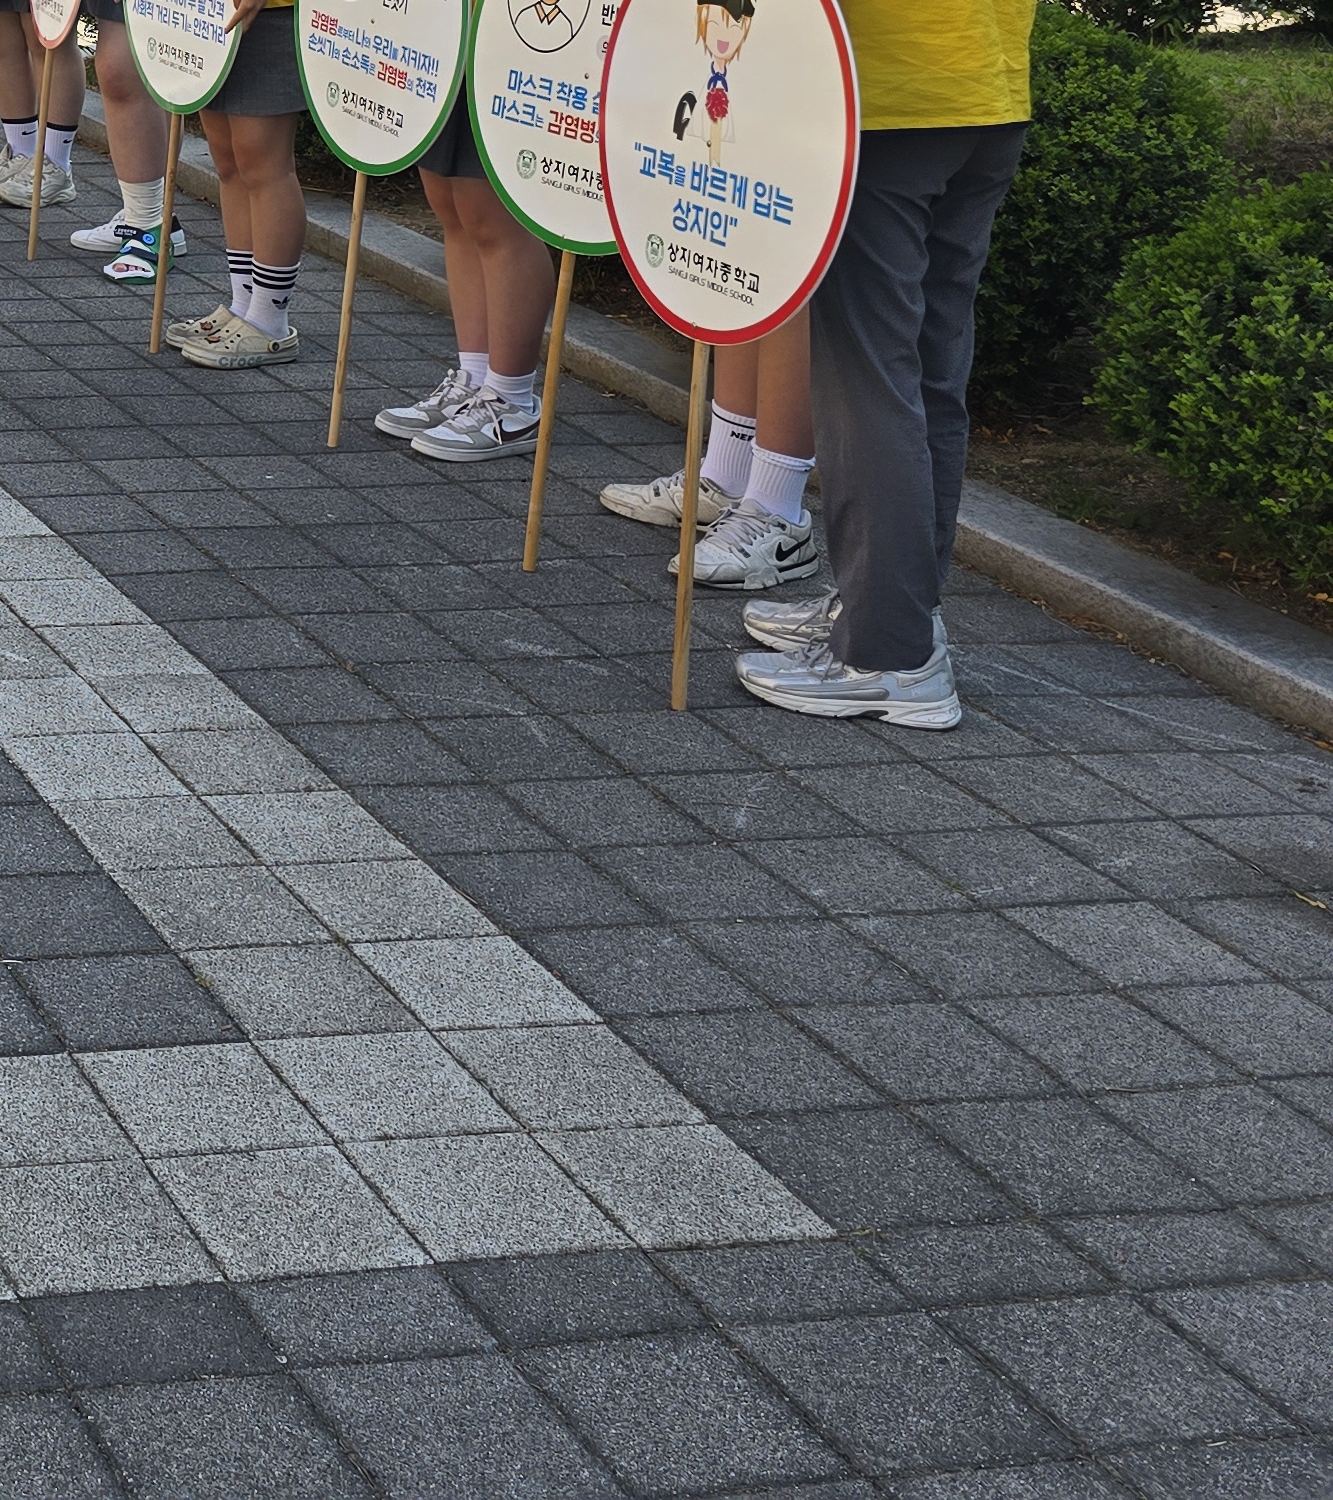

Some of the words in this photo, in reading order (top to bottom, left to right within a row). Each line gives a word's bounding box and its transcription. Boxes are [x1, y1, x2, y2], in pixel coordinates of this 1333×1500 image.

[155, 4, 171, 27] 거리
[193, 17, 226, 46] 안전거리
[310, 9, 355, 41] 감염병로부터
[372, 35, 399, 61] 우리를
[400, 45, 440, 78] 지키자!!
[157, 41, 204, 71] 상지여자중학교
[341, 46, 376, 77] 손소독은
[376, 61, 415, 93] 감염병의
[415, 76, 439, 104] 천적
[341, 88, 404, 129] 상지여자중학교
[507, 69, 554, 102] 마스크
[556, 81, 589, 111] 착용
[491, 94, 545, 129] 마스크는
[541, 176, 563, 189] SANGJI
[581, 188, 604, 203] MIDDLE
[690, 161, 749, 210] 바르게
[752, 181, 794, 226] 입는
[667, 242, 761, 295] 상지여자중학교
[668, 265, 688, 280] SANGJI
[706, 280, 729, 297] MIDDLE
[729, 288, 755, 306] SCHOOL
